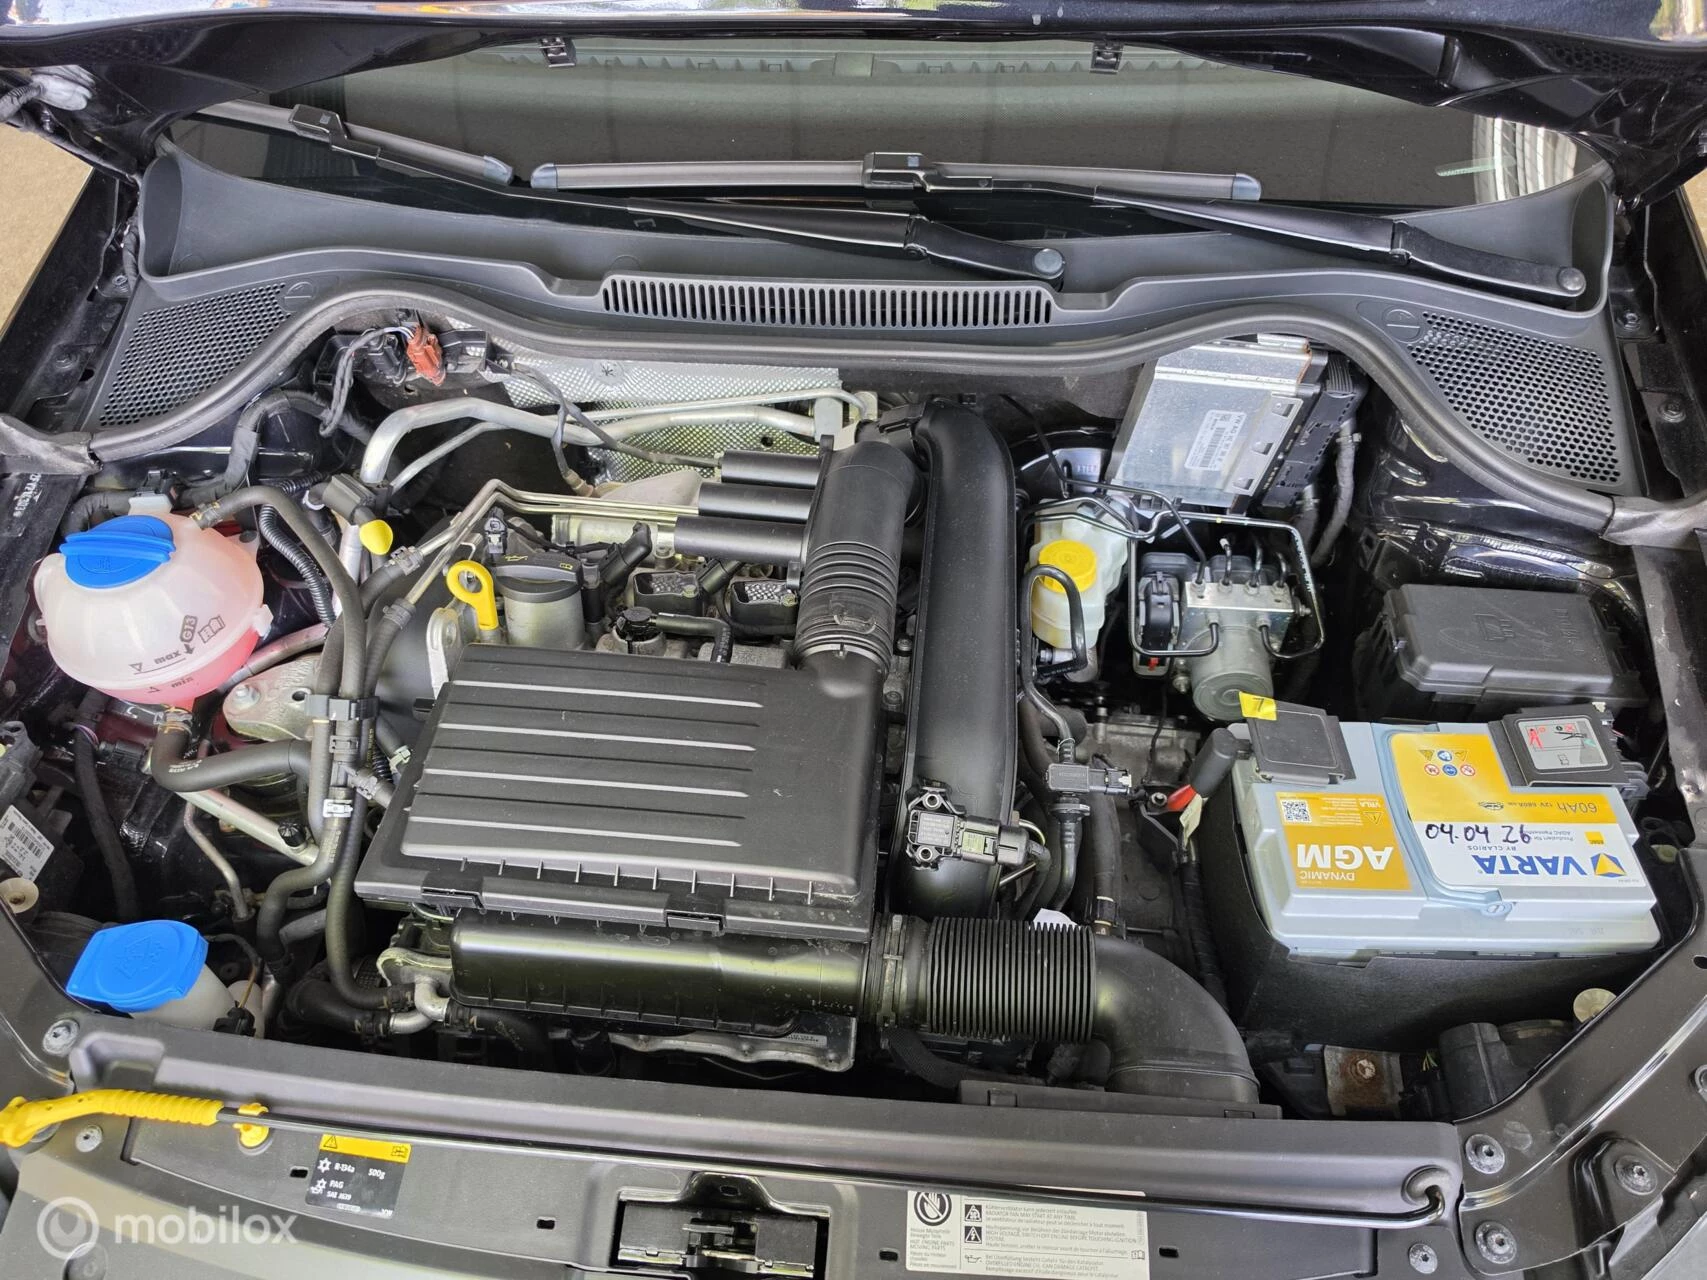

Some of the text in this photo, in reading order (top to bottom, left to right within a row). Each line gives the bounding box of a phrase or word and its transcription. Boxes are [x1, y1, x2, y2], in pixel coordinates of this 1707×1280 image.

[181, 616, 196, 641] G13
[154, 650, 181, 664] max
[171, 677, 193, 688] min
[1556, 802, 1598, 814] 60Ah
[1297, 843, 1394, 870] AGM
[1471, 855, 1588, 875] VARTA
[1300, 871, 1355, 881] DYNAMIC
[368, 1168, 386, 1180] 500g
[329, 1180, 344, 1189] PAG
